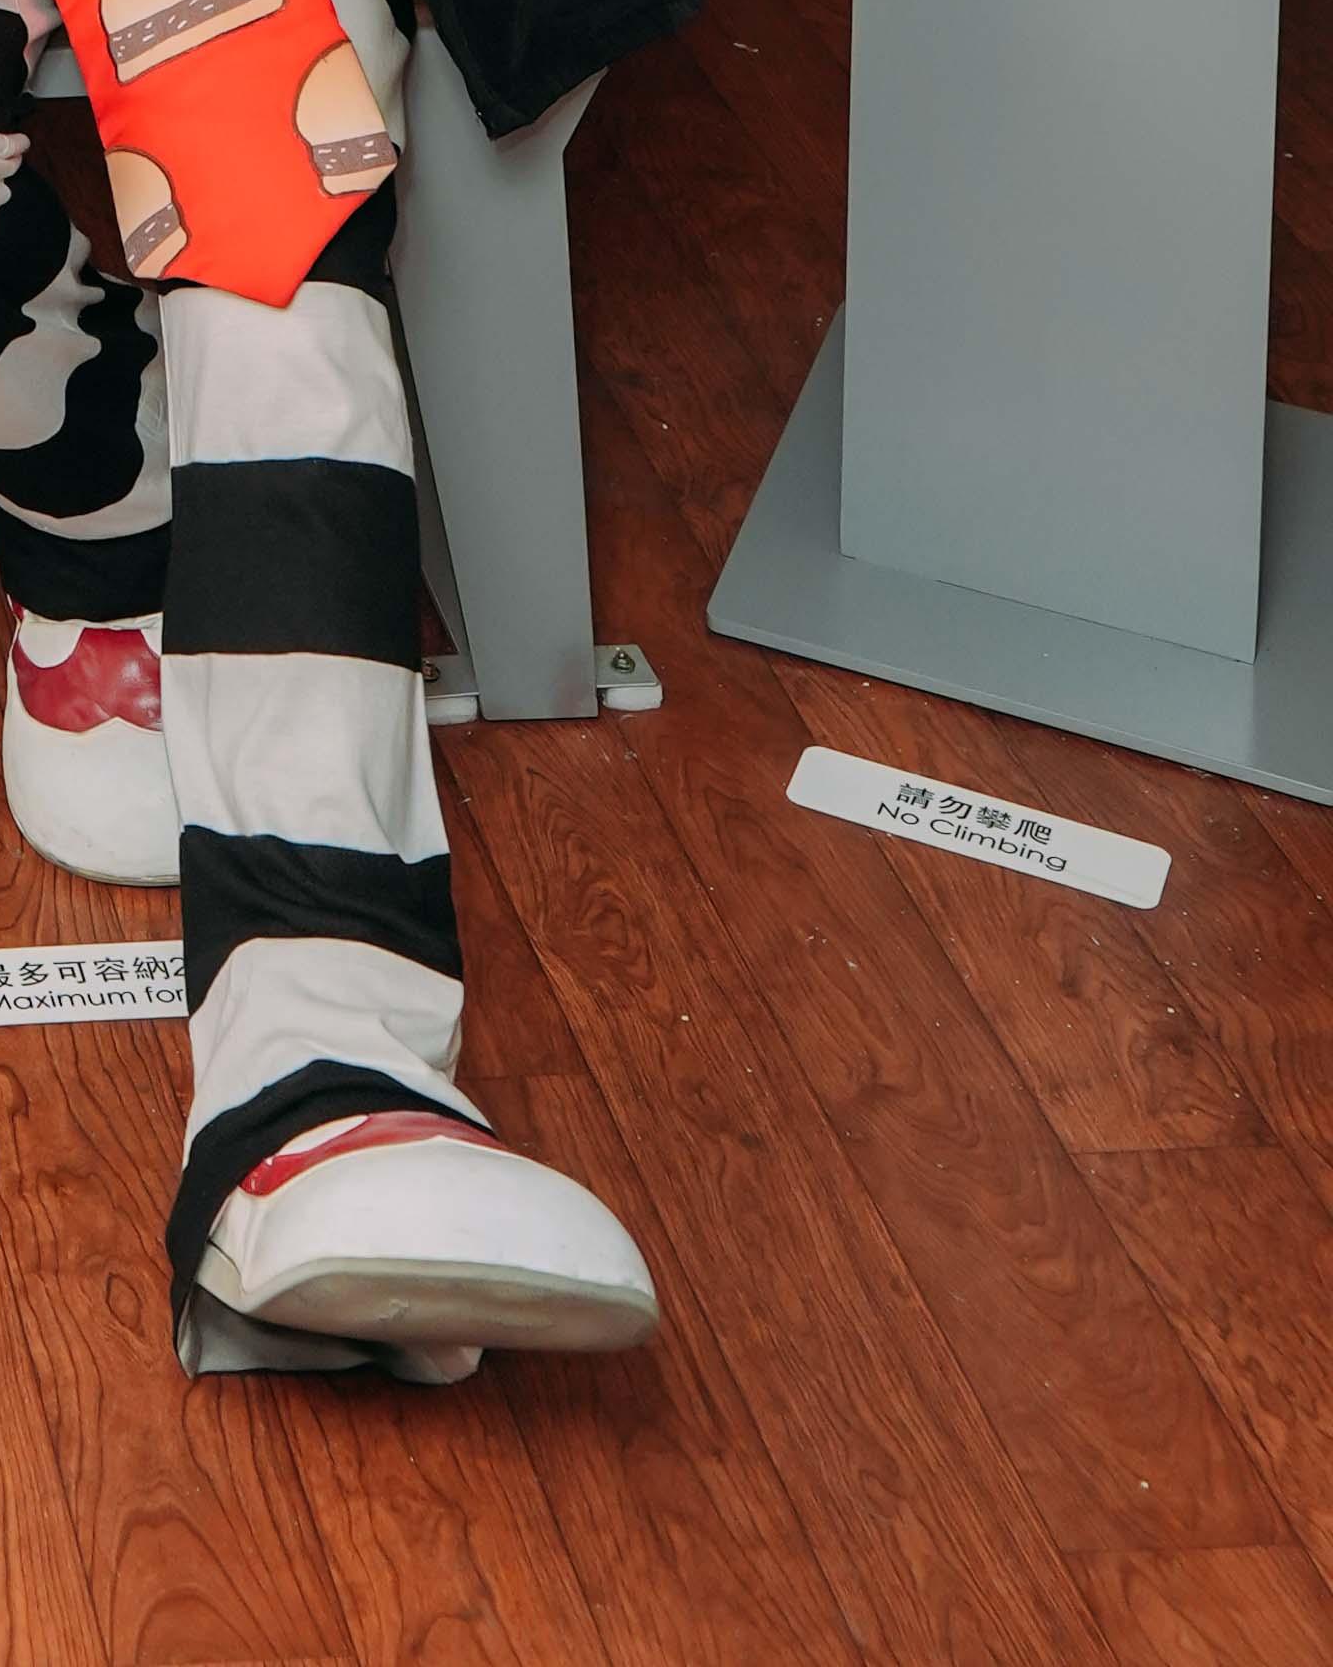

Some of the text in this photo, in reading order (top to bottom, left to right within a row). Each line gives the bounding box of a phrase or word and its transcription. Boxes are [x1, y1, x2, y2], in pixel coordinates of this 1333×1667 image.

[876, 802, 1068, 872] No Climbing
[895, 782, 1053, 846] 請勿攀爬
[145, 986, 184, 1004] for
